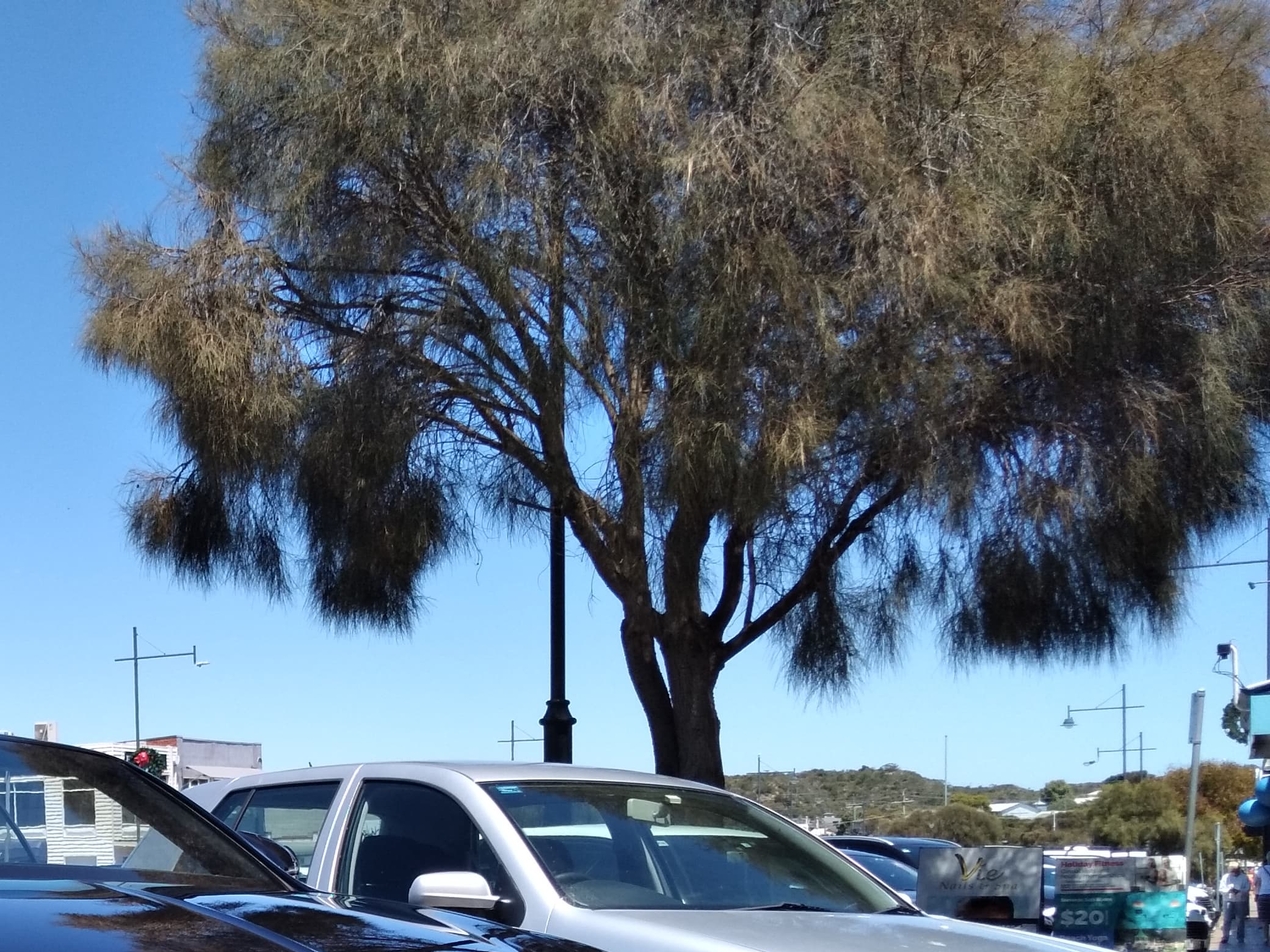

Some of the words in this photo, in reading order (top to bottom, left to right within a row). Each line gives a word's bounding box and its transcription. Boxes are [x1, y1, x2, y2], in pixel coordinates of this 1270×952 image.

[955, 853, 1004, 881] Vie
[939, 881, 974, 890] Nails
[994, 882, 1018, 892] Spa
[1060, 909, 1105, 927] $20
